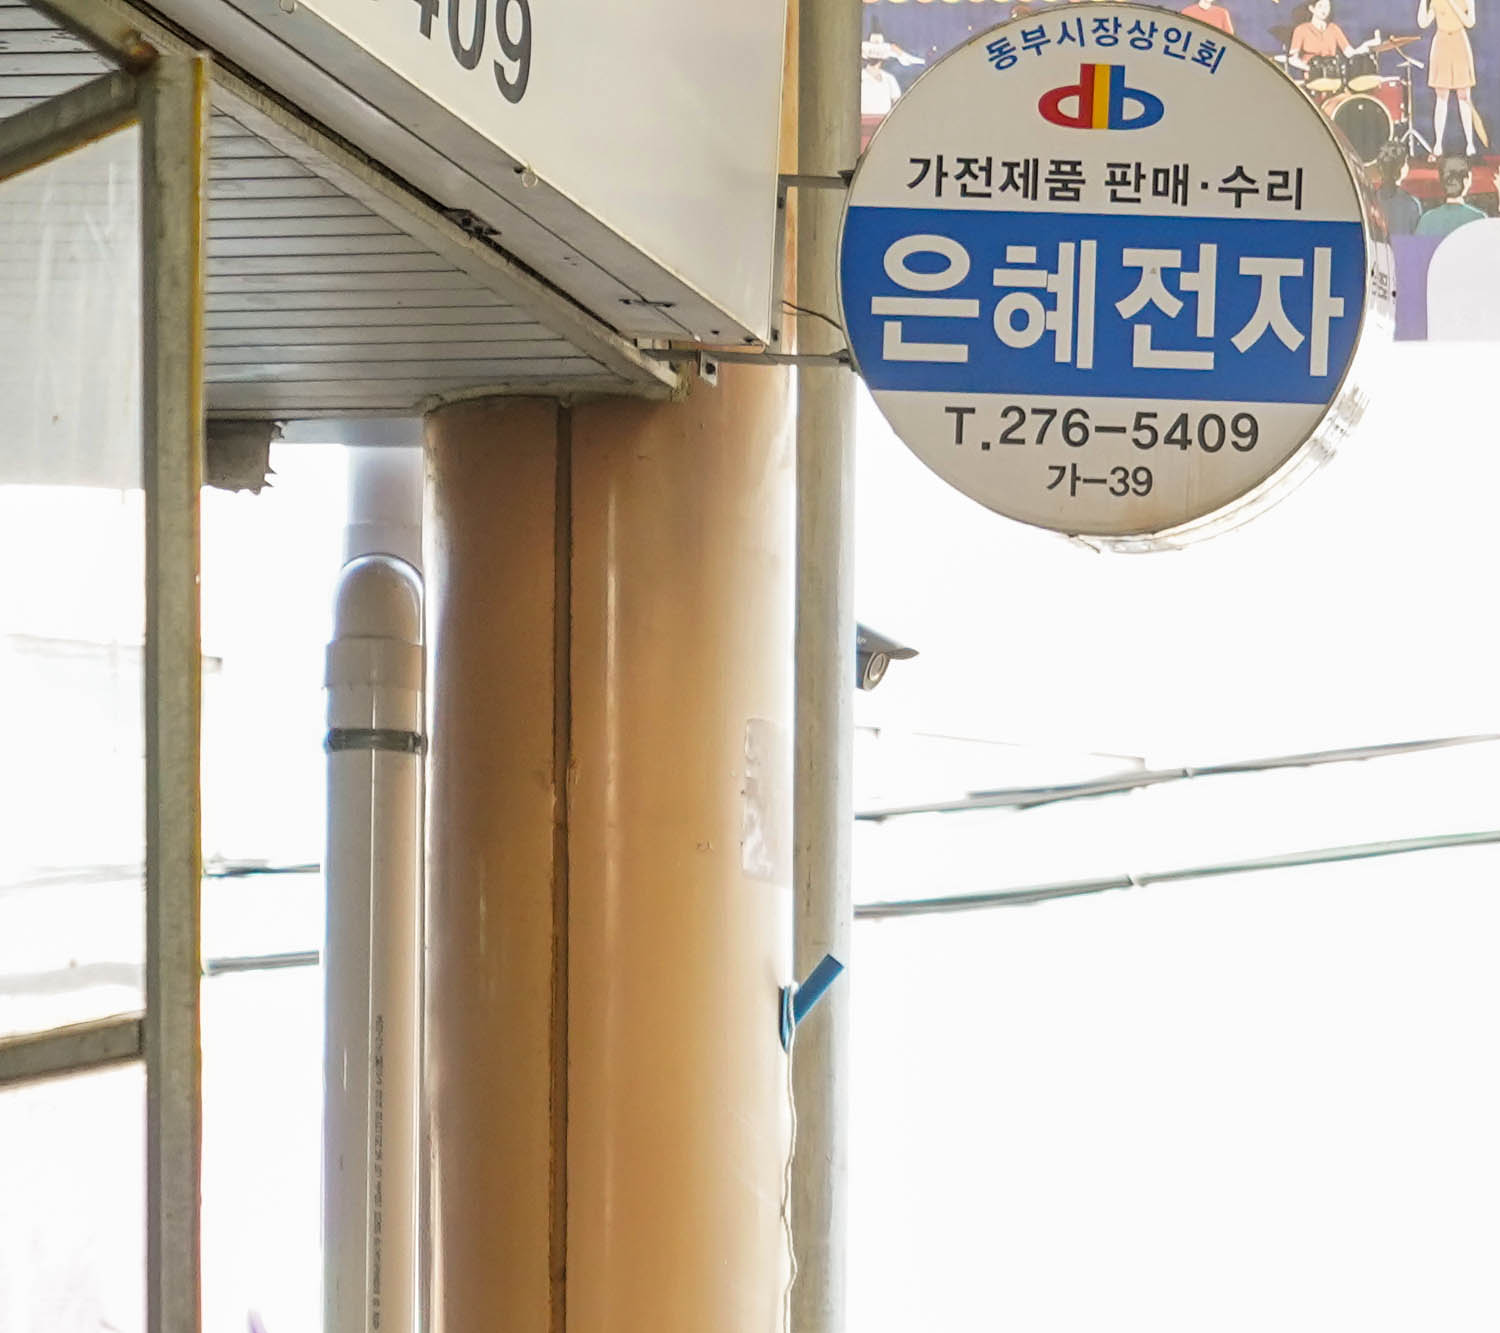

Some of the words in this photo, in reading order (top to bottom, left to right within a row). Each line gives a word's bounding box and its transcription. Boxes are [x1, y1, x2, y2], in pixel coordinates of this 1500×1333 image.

[986, 17, 1228, 75] 동부시장상인회
[906, 153, 1087, 202] 가전제품
[871, 233, 1345, 377] 은혜전자
[945, 405, 1260, 453] T.276-5409
[1046, 462, 1154, 498] 가-39
